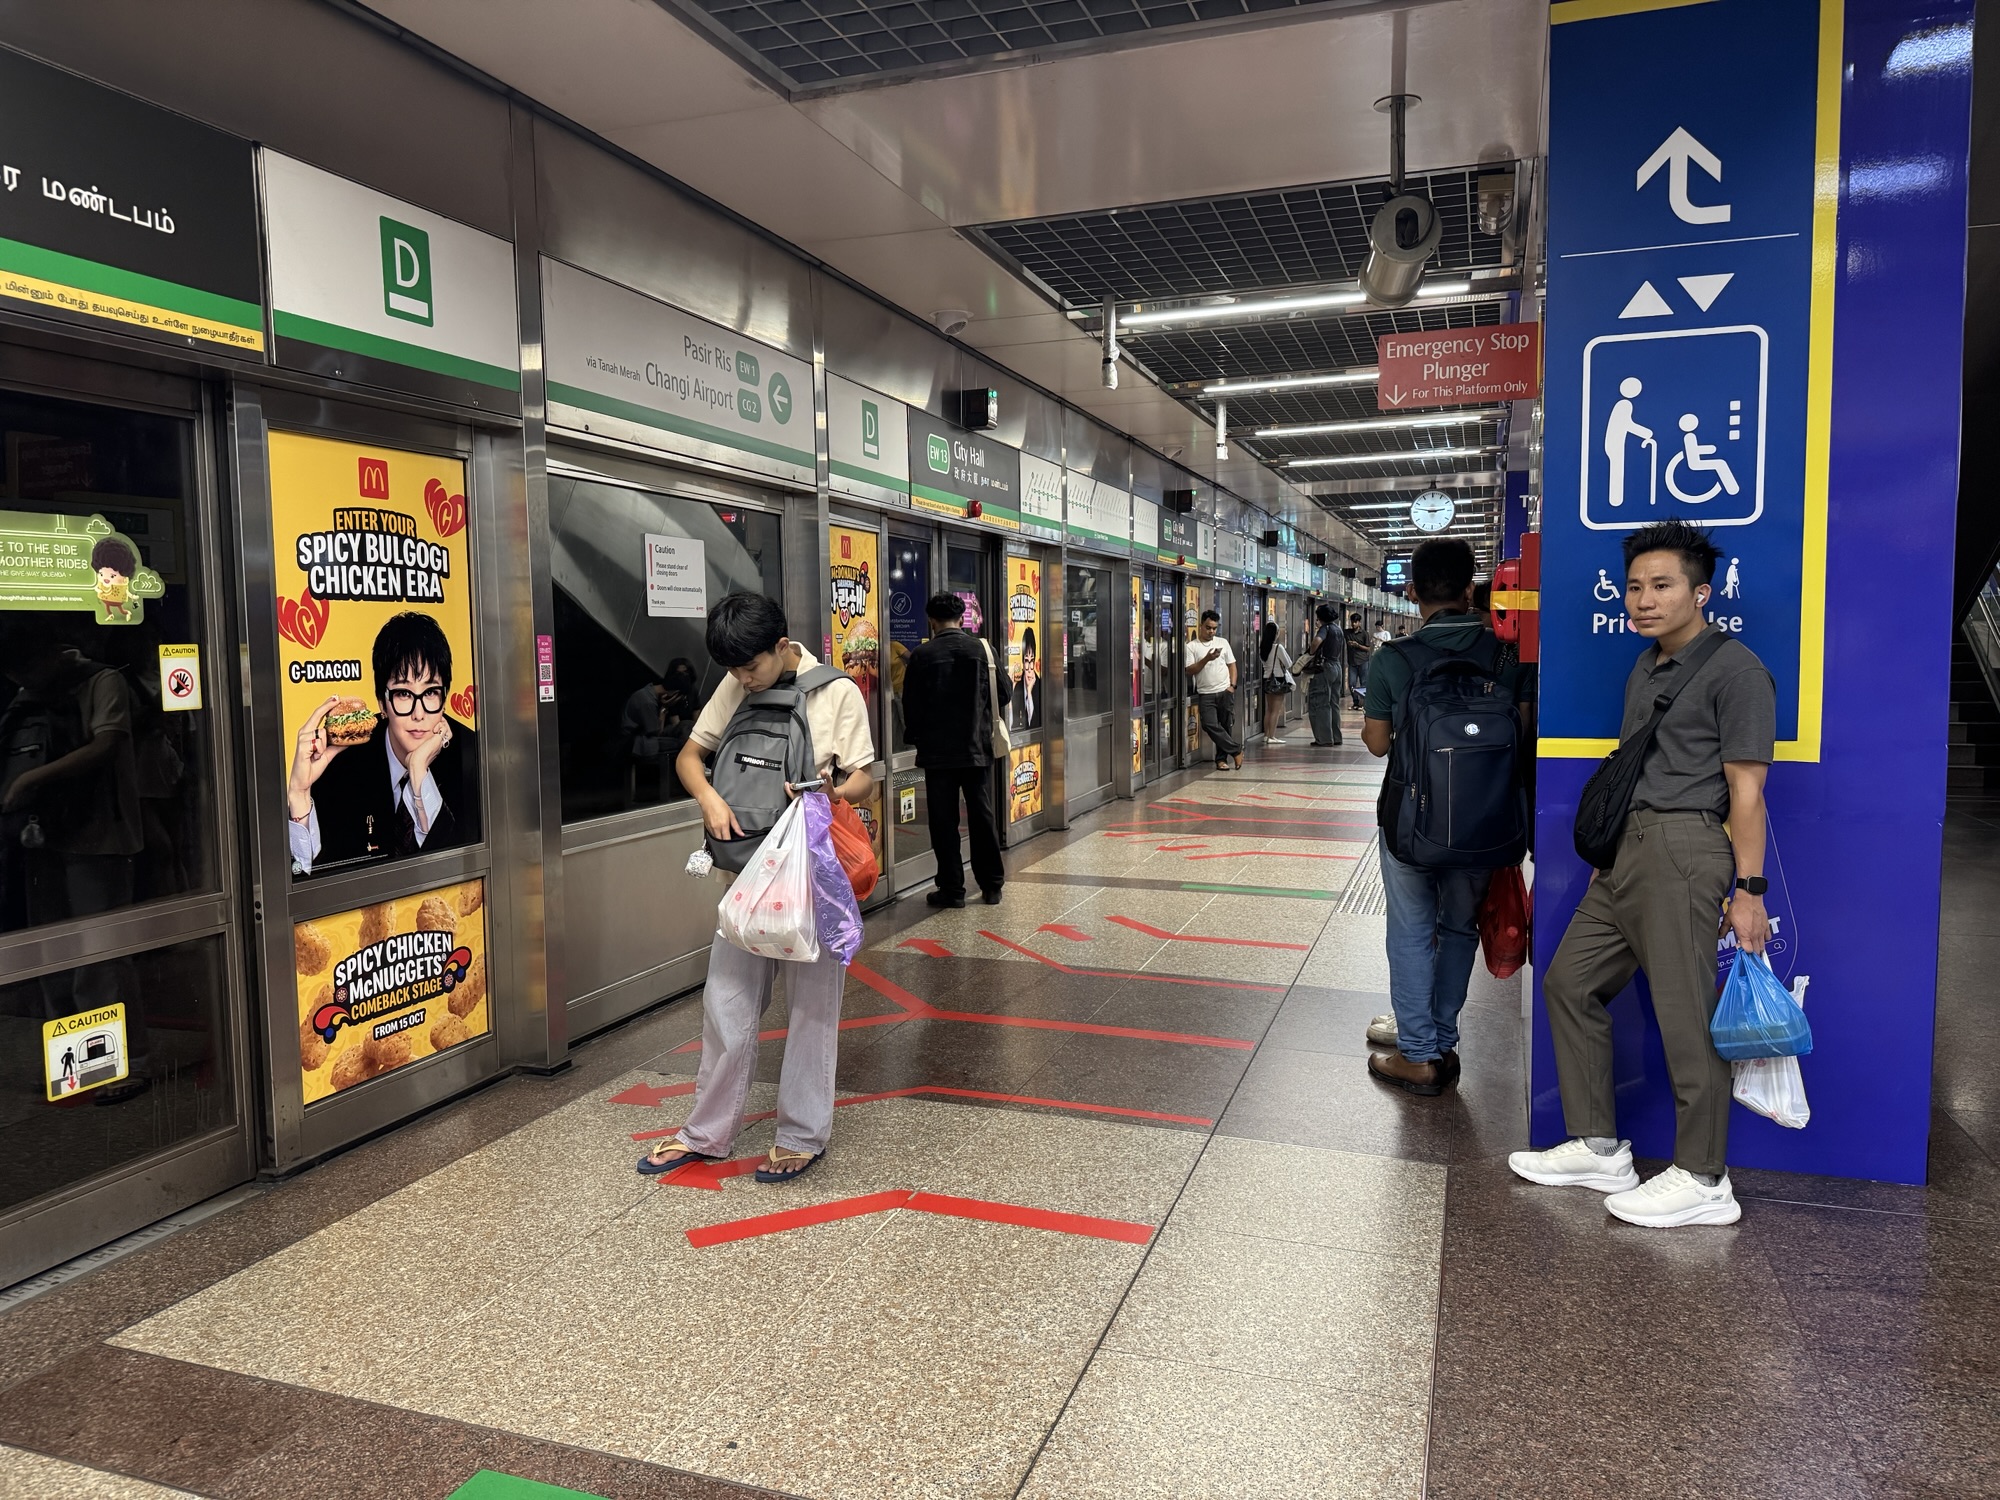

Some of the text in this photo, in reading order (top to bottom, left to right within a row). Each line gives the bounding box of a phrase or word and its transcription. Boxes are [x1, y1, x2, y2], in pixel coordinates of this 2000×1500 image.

[42, 175, 176, 235] மண்டபம்
[393, 237, 420, 289] D
[5, 281, 256, 345] மின்னும் போது தயவுசெய்து உள்ளே நுழையாதீர்கள்
[683, 335, 732, 373] Pasir Ris
[1386, 333, 1530, 360] Emergency Stop
[586, 356, 641, 382] via Tanah Merah
[739, 360, 756, 376] EW 1
[1423, 362, 1490, 382] Plunger
[645, 362, 734, 410] Changi Airport
[1412, 380, 1528, 399] For This Platform Only
[742, 398, 752, 412] CG
[865, 411, 875, 440] D
[929, 445, 948, 464] EW 13
[953, 440, 985, 468] City Hall
[335, 510, 416, 538] ENTER YOUR
[7, 541, 24, 553] TO
[27, 542, 50, 554] THE
[53, 544, 78, 556] SIDE
[298, 532, 448, 573] SPICY BULGOGI
[655, 544, 676, 555] Caution
[56, 558, 88, 570] RIDES
[310, 564, 443, 598] CHICKEN ERA
[682, 586, 703, 594] automatically
[1708, 611, 1743, 633] se
[291, 662, 360, 681] G-DRAGON
[335, 932, 452, 987] SPICY CHICKEN
[351, 976, 443, 1020] COMEBACK STAGE
[68, 1008, 118, 1030] CAUTION
[374, 1010, 425, 1039] FROM 15 OCT
